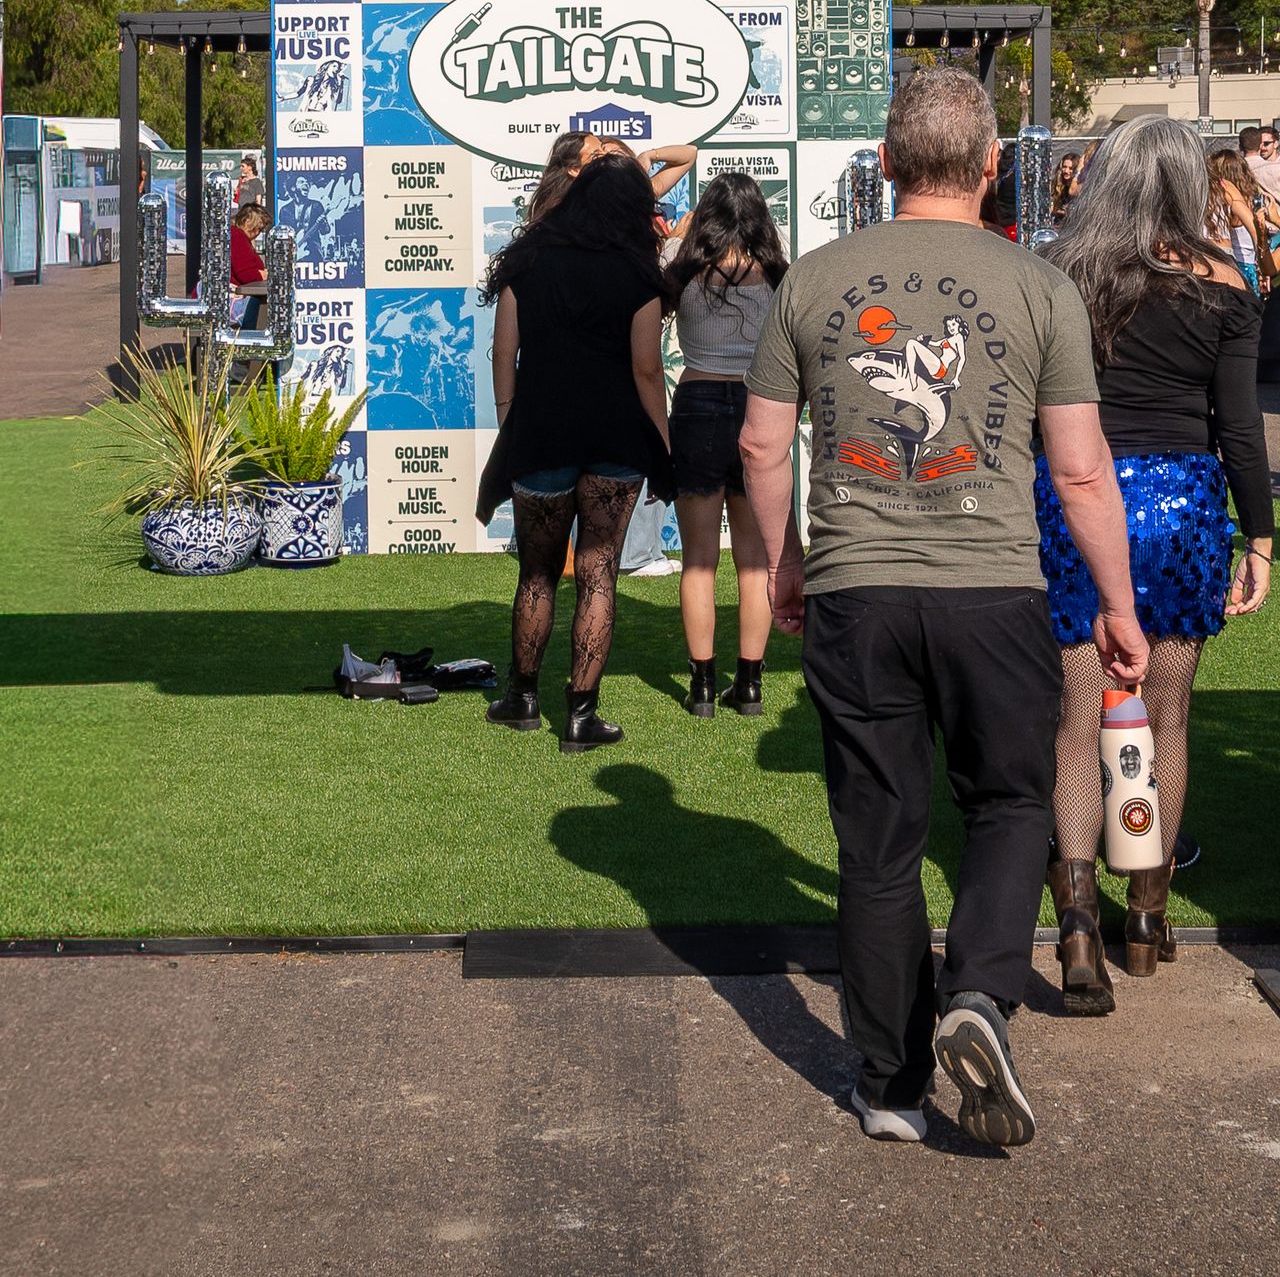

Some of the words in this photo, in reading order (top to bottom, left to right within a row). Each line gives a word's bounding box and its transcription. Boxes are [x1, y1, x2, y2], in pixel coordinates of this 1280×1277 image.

[275, 16, 349, 32] UPPORT
[555, 6, 603, 29] THE
[739, 12, 782, 26] FROM
[299, 31, 316, 39] LIVE
[455, 33, 705, 100] TAILGATE
[746, 95, 782, 106] VISTA
[508, 124, 541, 134] BUILT
[545, 123, 561, 133] BY
[711, 157, 744, 166] CHULA
[746, 156, 775, 165] VISTA
[391, 162, 445, 175] GOLDEN
[753, 166, 779, 175] MIND
[398, 175, 439, 189] HOUR.
[404, 203, 433, 216] LIVE
[395, 217, 443, 230] MUSIC.
[400, 244, 438, 258] GOOD
[385, 258, 454, 271] COMPANY.
[904, 272, 923, 293] &
[296, 302, 353, 317] PPORT
[303, 316, 320, 324] LIVE
[820, 275, 888, 369] TIDES
[937, 277, 1007, 361] GOOD
[296, 322, 354, 344] USIC
[820, 385, 836, 461] HIGH
[984, 381, 1009, 470] VIBES
[395, 446, 449, 459] GOLDEN
[401, 460, 443, 473] HOUR.
[407, 488, 437, 501] LIVE
[867, 482, 900, 497] CRUZ
[917, 481, 995, 500] CALIFORNIA
[398, 501, 447, 514] MUSIC.
[877, 501, 910, 512] SINCE
[404, 529, 441, 542] GOOD
